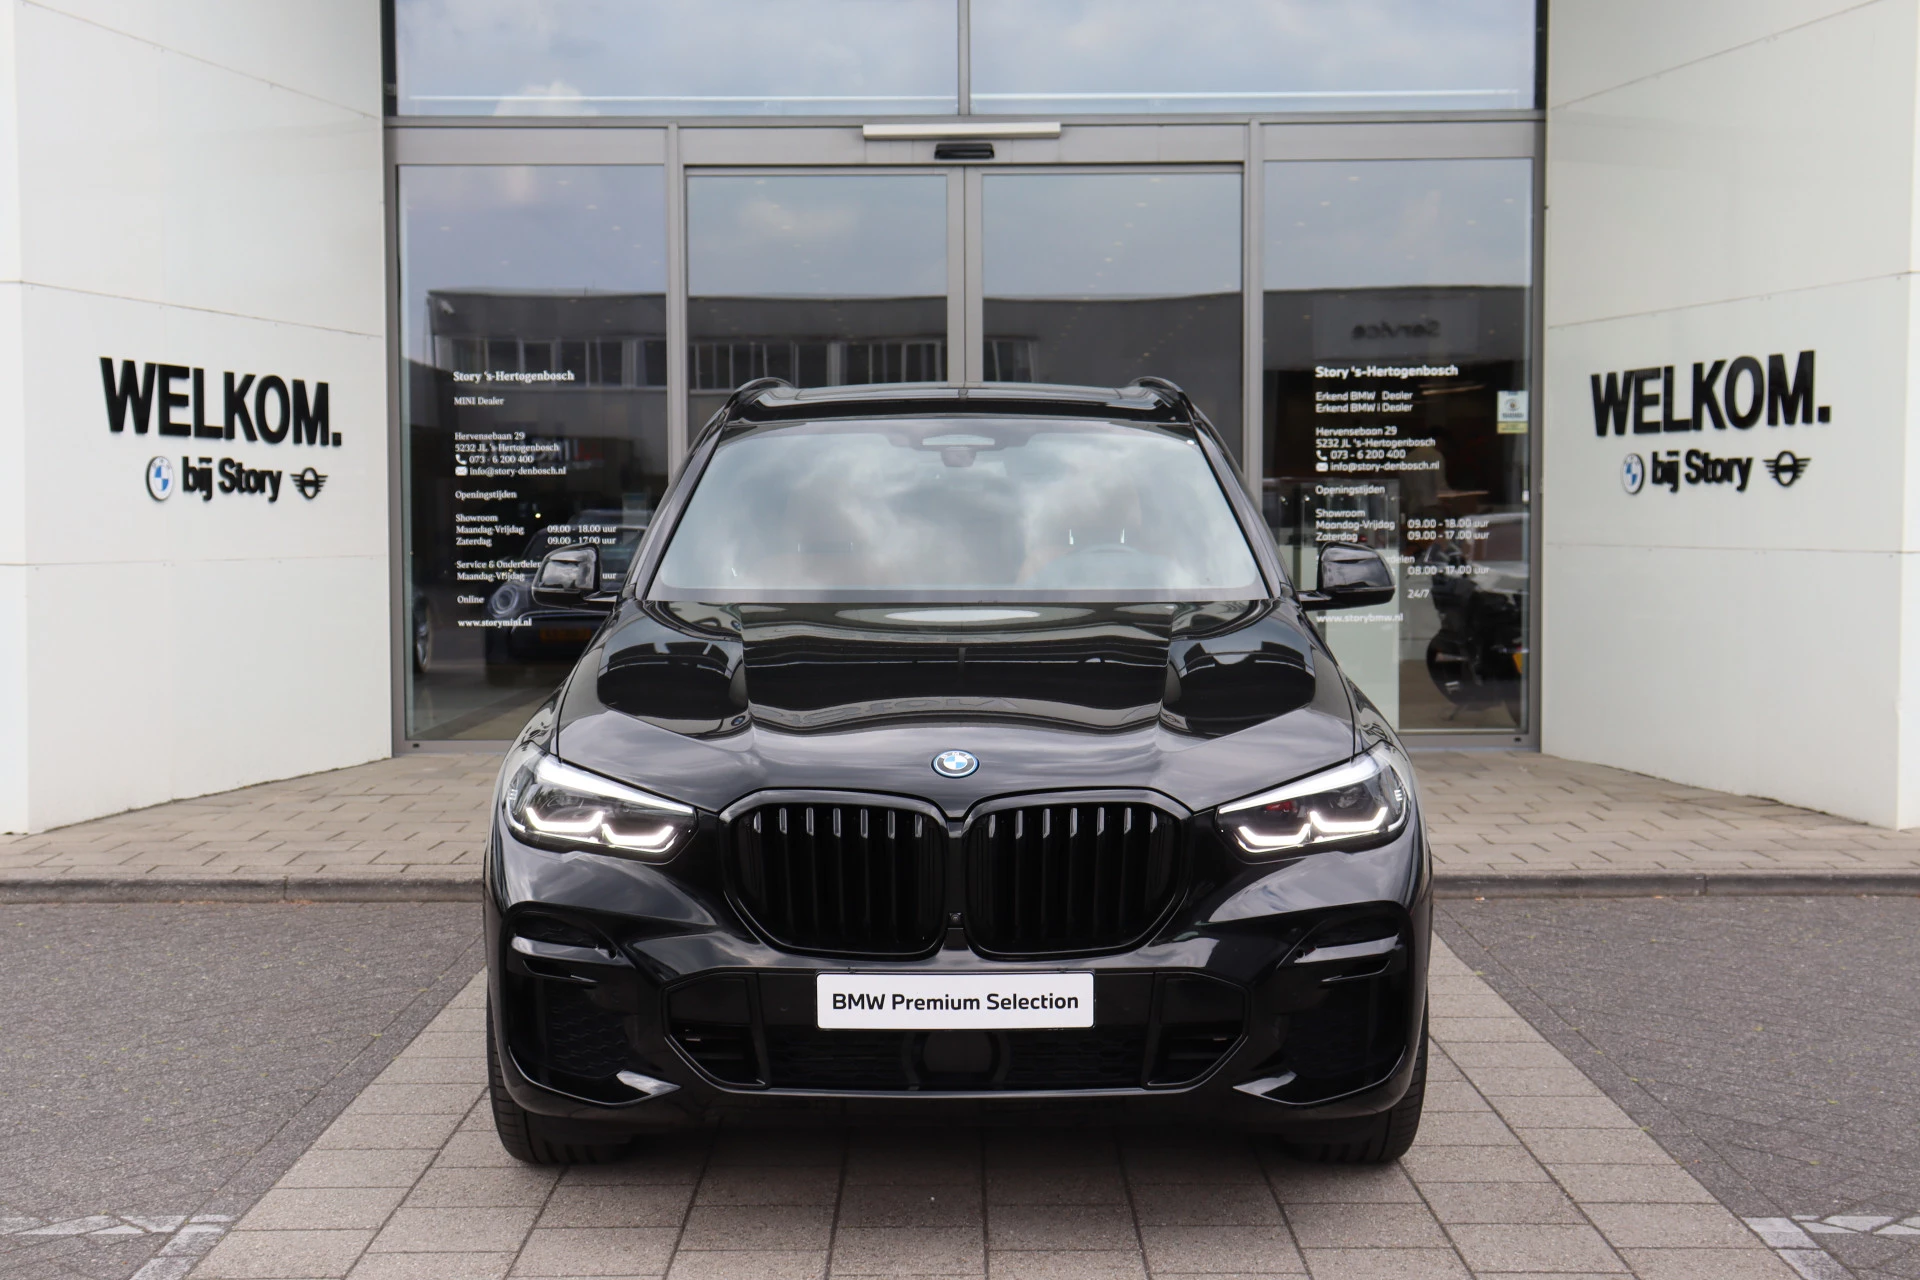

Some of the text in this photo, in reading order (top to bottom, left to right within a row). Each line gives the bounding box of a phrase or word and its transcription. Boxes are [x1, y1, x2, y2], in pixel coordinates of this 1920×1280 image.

[453, 371, 482, 384] Story
[1315, 366, 1349, 380] Story
[1315, 391, 1413, 401] Erkend BMW Dealer
[1591, 350, 1831, 437] WELKOM.
[100, 356, 342, 446] WELKOM.
[454, 396, 504, 406] MINI Dealer
[1315, 403, 1348, 413] Erkend
[1350, 403, 1376, 412] BMW
[1382, 403, 1413, 412] Dealer
[454, 431, 526, 441] Hervensebaan 29
[1316, 426, 1398, 436] Hervensebaan 29
[455, 443, 476, 453] 5232
[478, 443, 487, 452] JL
[1316, 439, 1339, 448] 5232
[1341, 439, 1351, 448] JL
[469, 455, 486, 464] 073
[492, 455, 499, 464] 6
[500, 455, 516, 464] 200
[517, 455, 534, 464] 400
[1330, 450, 1348, 459] 073
[1357, 450, 1364, 459] 6
[1365, 450, 1385, 459] 200
[1386, 450, 1406, 459] 400
[469, 466, 567, 477] info@story-denbosch.nl
[1330, 461, 1440, 472] info@story-denbosch.nl
[1652, 449, 1753, 493] bij Story
[182, 456, 282, 503] bij Story
[455, 490, 518, 501] Openingstijden
[1315, 485, 1386, 496] Openingstijden
[456, 514, 498, 523] Showroom
[1315, 509, 1366, 518] Showroom
[1316, 520, 1396, 531] Maandag-Vrijdag
[1407, 519, 1437, 528] 09.00
[1444, 519, 1472, 528] 18.00
[1473, 520, 1490, 528] uur
[456, 525, 525, 536] Maandag-Vrijdag
[547, 525, 571, 533] 09.00
[578, 525, 601, 533] 18.00
[456, 537, 492, 547] Zaterdag
[547, 536, 571, 545] 09.00
[602, 537, 617, 545] uur
[1316, 532, 1358, 542] Zaterdag
[1407, 531, 1437, 540] 09.00
[1473, 532, 1490, 540] uur
[456, 560, 488, 569] Service
[488, 560, 495, 569] &
[1407, 566, 1437, 575] 08.00
[1473, 567, 1490, 575] uur
[457, 572, 525, 582] Maandag-Vrijdag
[1407, 589, 1430, 599] 24/7
[457, 595, 485, 604] Online
[457, 618, 532, 628] www.storymini.nl
[1316, 613, 1404, 624] www.storybmw.nl
[832, 992, 1079, 1011] BMW Premium Selection
